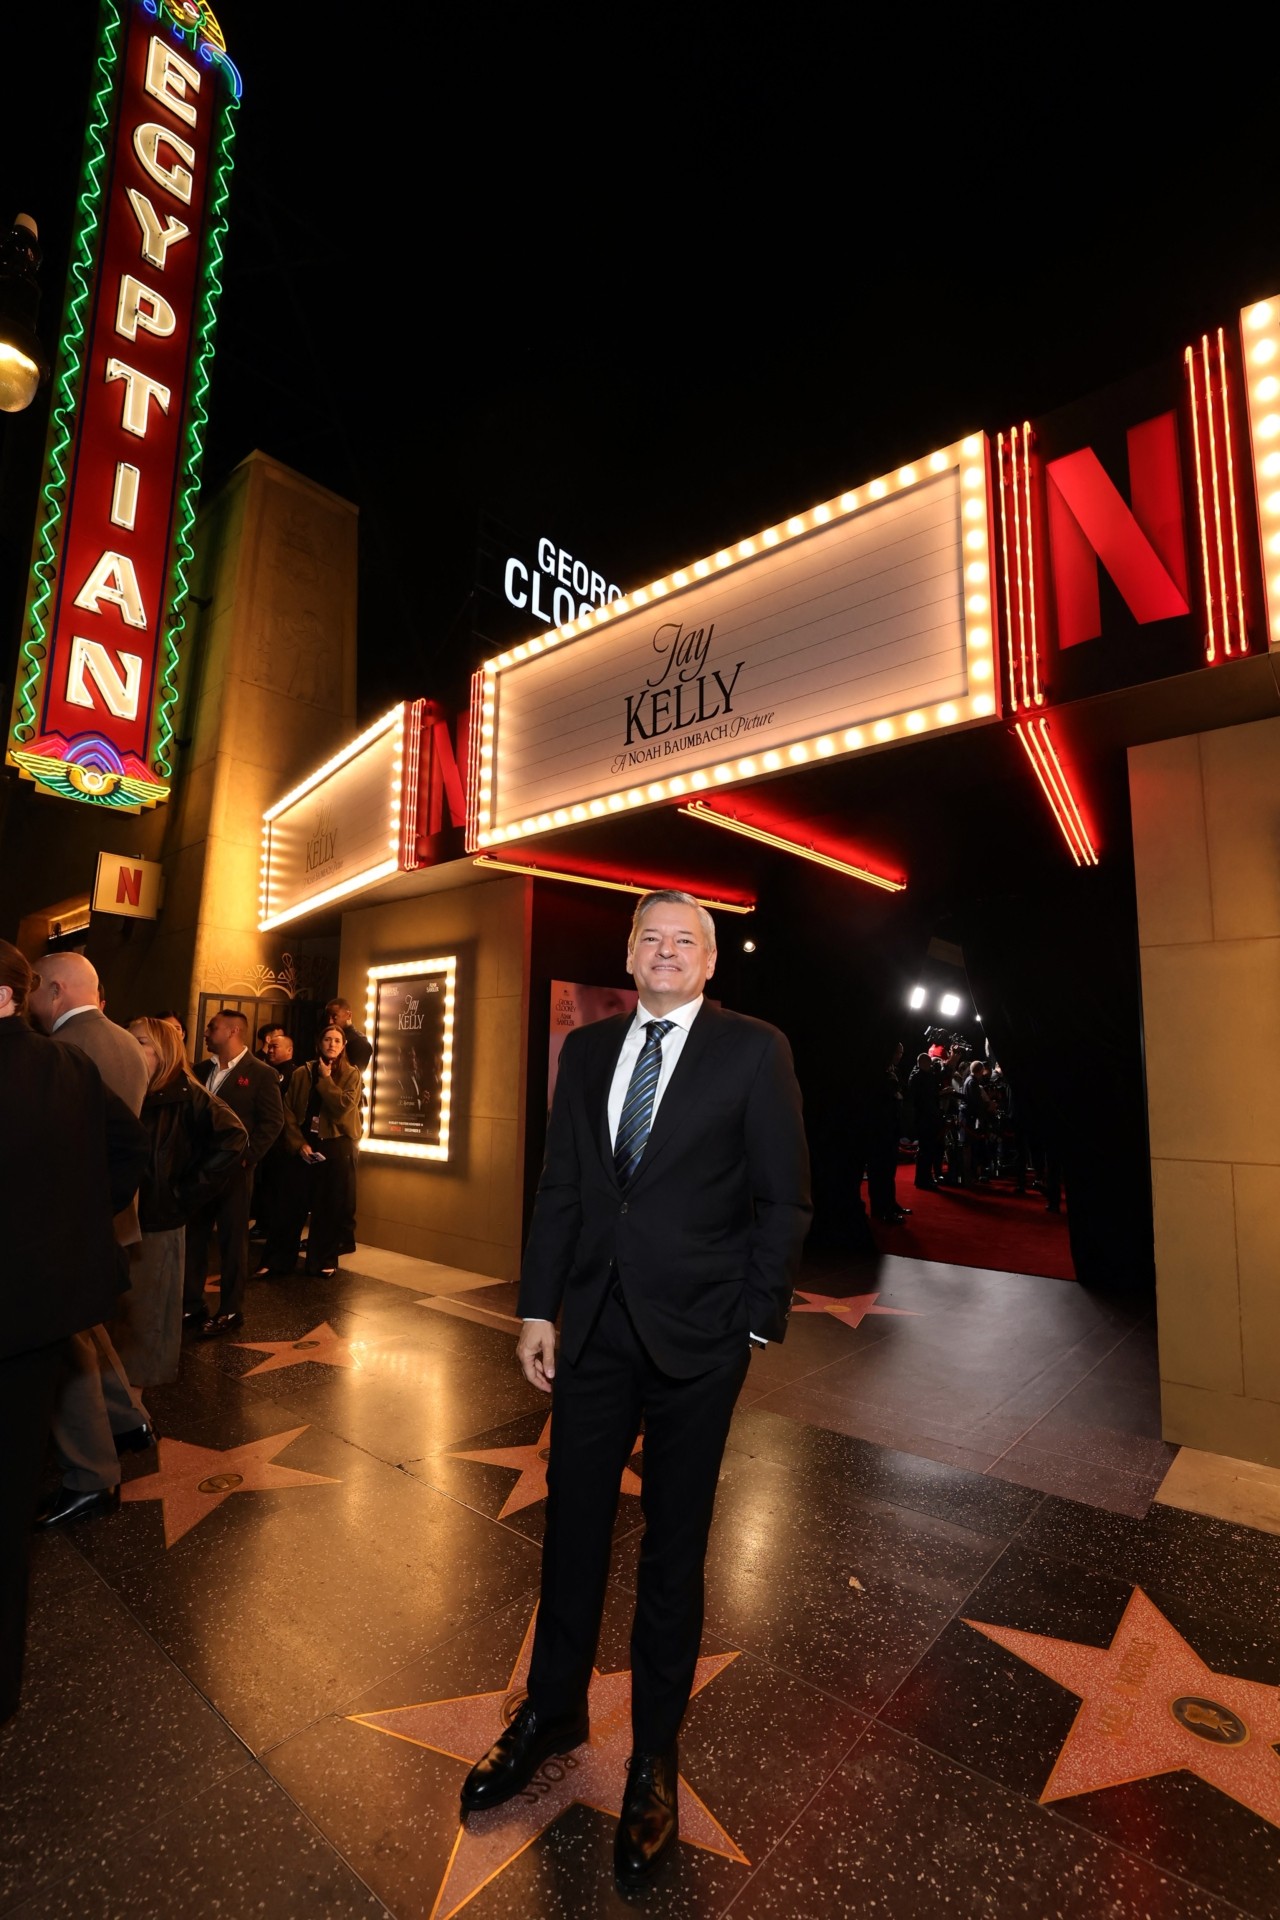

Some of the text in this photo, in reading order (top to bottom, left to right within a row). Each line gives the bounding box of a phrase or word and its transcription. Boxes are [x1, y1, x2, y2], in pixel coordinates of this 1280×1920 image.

[66, 35, 201, 721] EGYPTIAN
[1045, 408, 1190, 650] N
[537, 537, 628, 609] GEOR
[646, 622, 715, 687] Jay
[624, 661, 746, 746] KELLY
[611, 711, 775, 774] A NOAH BAUMBACH Picture
[305, 827, 338, 873] KELLY
[115, 866, 143, 907] N
[398, 1013, 425, 1031] KELLY
